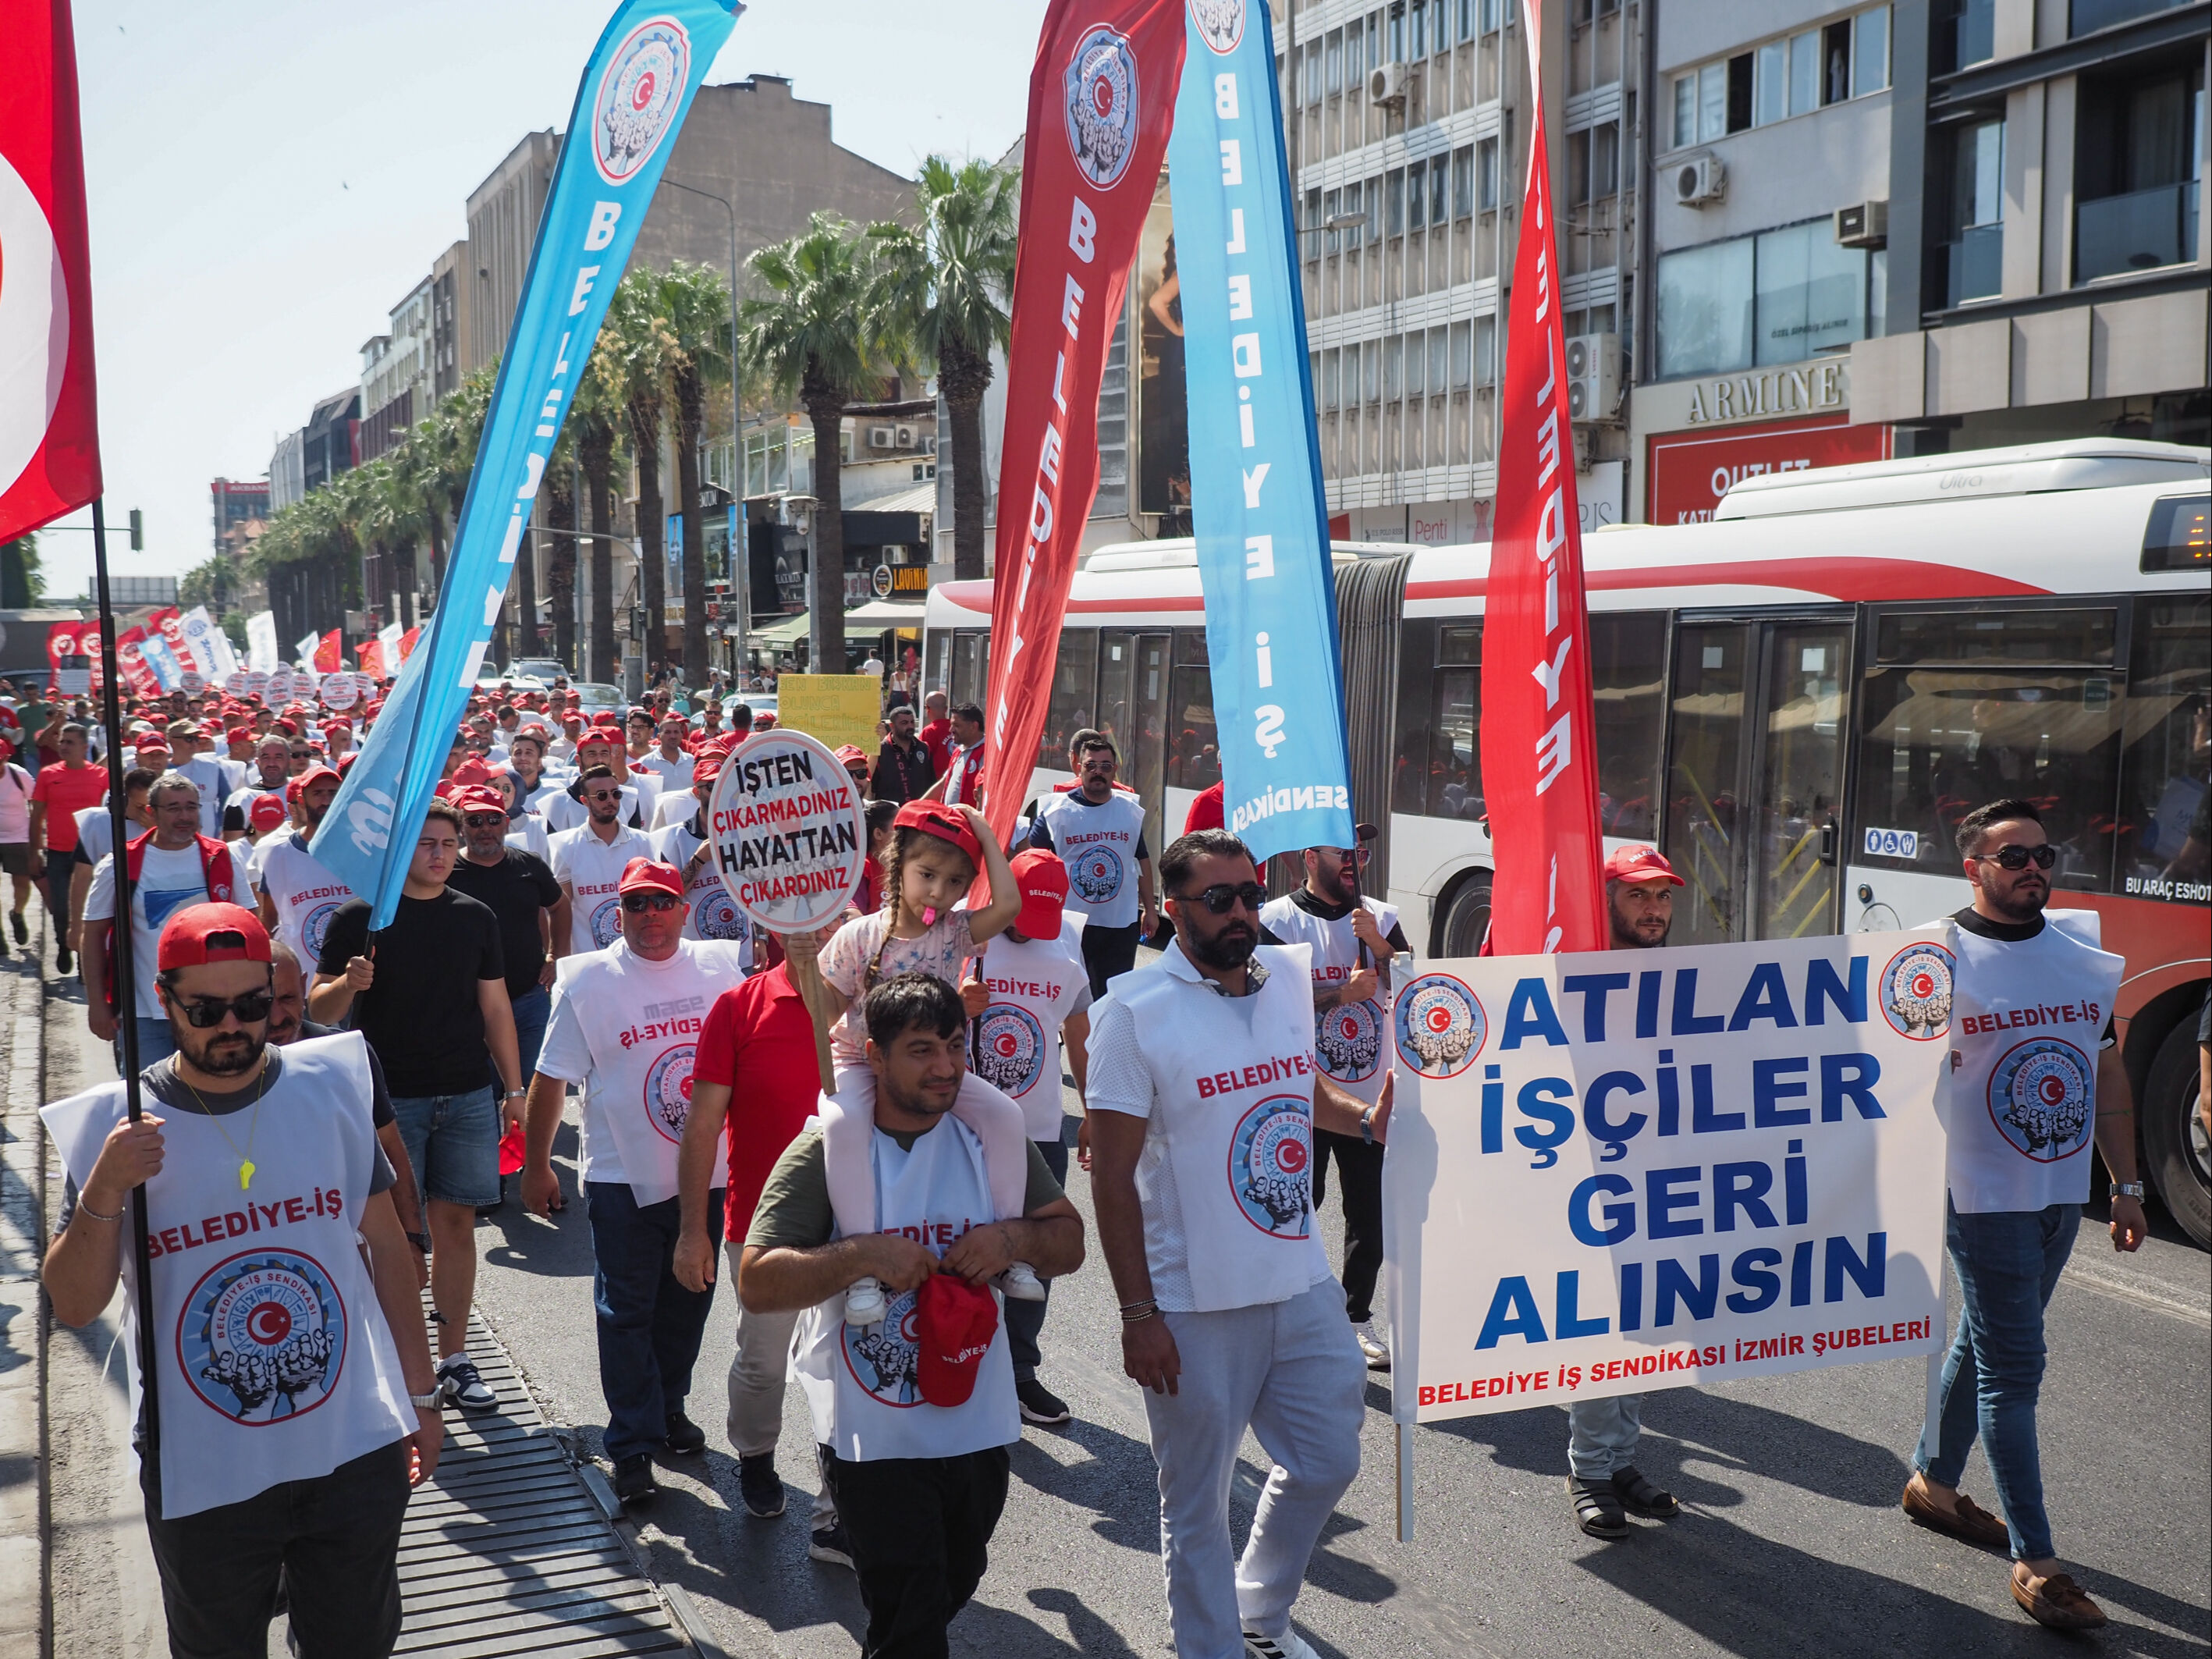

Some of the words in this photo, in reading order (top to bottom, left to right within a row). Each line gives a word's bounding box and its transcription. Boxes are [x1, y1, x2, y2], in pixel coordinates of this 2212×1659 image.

[1686, 363, 1845, 425] ARMINE
[1940, 472, 1983, 491] Ultra
[1415, 518, 1448, 542] Penti
[734, 750, 813, 798] İŞTEN
[713, 787, 851, 837] ÇIKARMADINIZ
[719, 820, 858, 874] HAYATTAN
[1065, 830, 1130, 845] BELEDİYE-İŞ
[290, 884, 353, 907] BELEDİYE
[740, 866, 850, 908] ÇIKARDINIZ
[2125, 876, 2142, 894] BU
[2142, 879, 2175, 901] ARAÇ
[986, 976, 1062, 1002] EDİYE-İŞ
[1499, 954, 1869, 1051] ATILAN
[1961, 999, 2100, 1036] BELEDİYE-İŞ
[1196, 1049, 1315, 1099] BELEDİYE-İ
[2016, 1054, 2049, 1096] BELEDİYE-İŞ
[2050, 1054, 2082, 1091] SENDİKASI
[1481, 1049, 1887, 1170] İŞÇİLER
[1255, 1114, 1284, 1167] BELEDİYE-İŞ
[1568, 1139, 1809, 1247] GERİ
[147, 1186, 345, 1261] BELEDİYE-İŞ
[217, 1274, 261, 1339] BELEDİYE-İŞ
[267, 1273, 318, 1316] SENDİKASI
[1473, 1231, 1887, 1351] ALINSIN
[1417, 1370, 1549, 1407] BELEDİYE
[1557, 1362, 1582, 1392] İŞ
[1589, 1343, 1726, 1383] SENDİKASI
[1734, 1332, 1805, 1363] İZMİR
[1812, 1314, 1931, 1358] ŞUBELERİ
